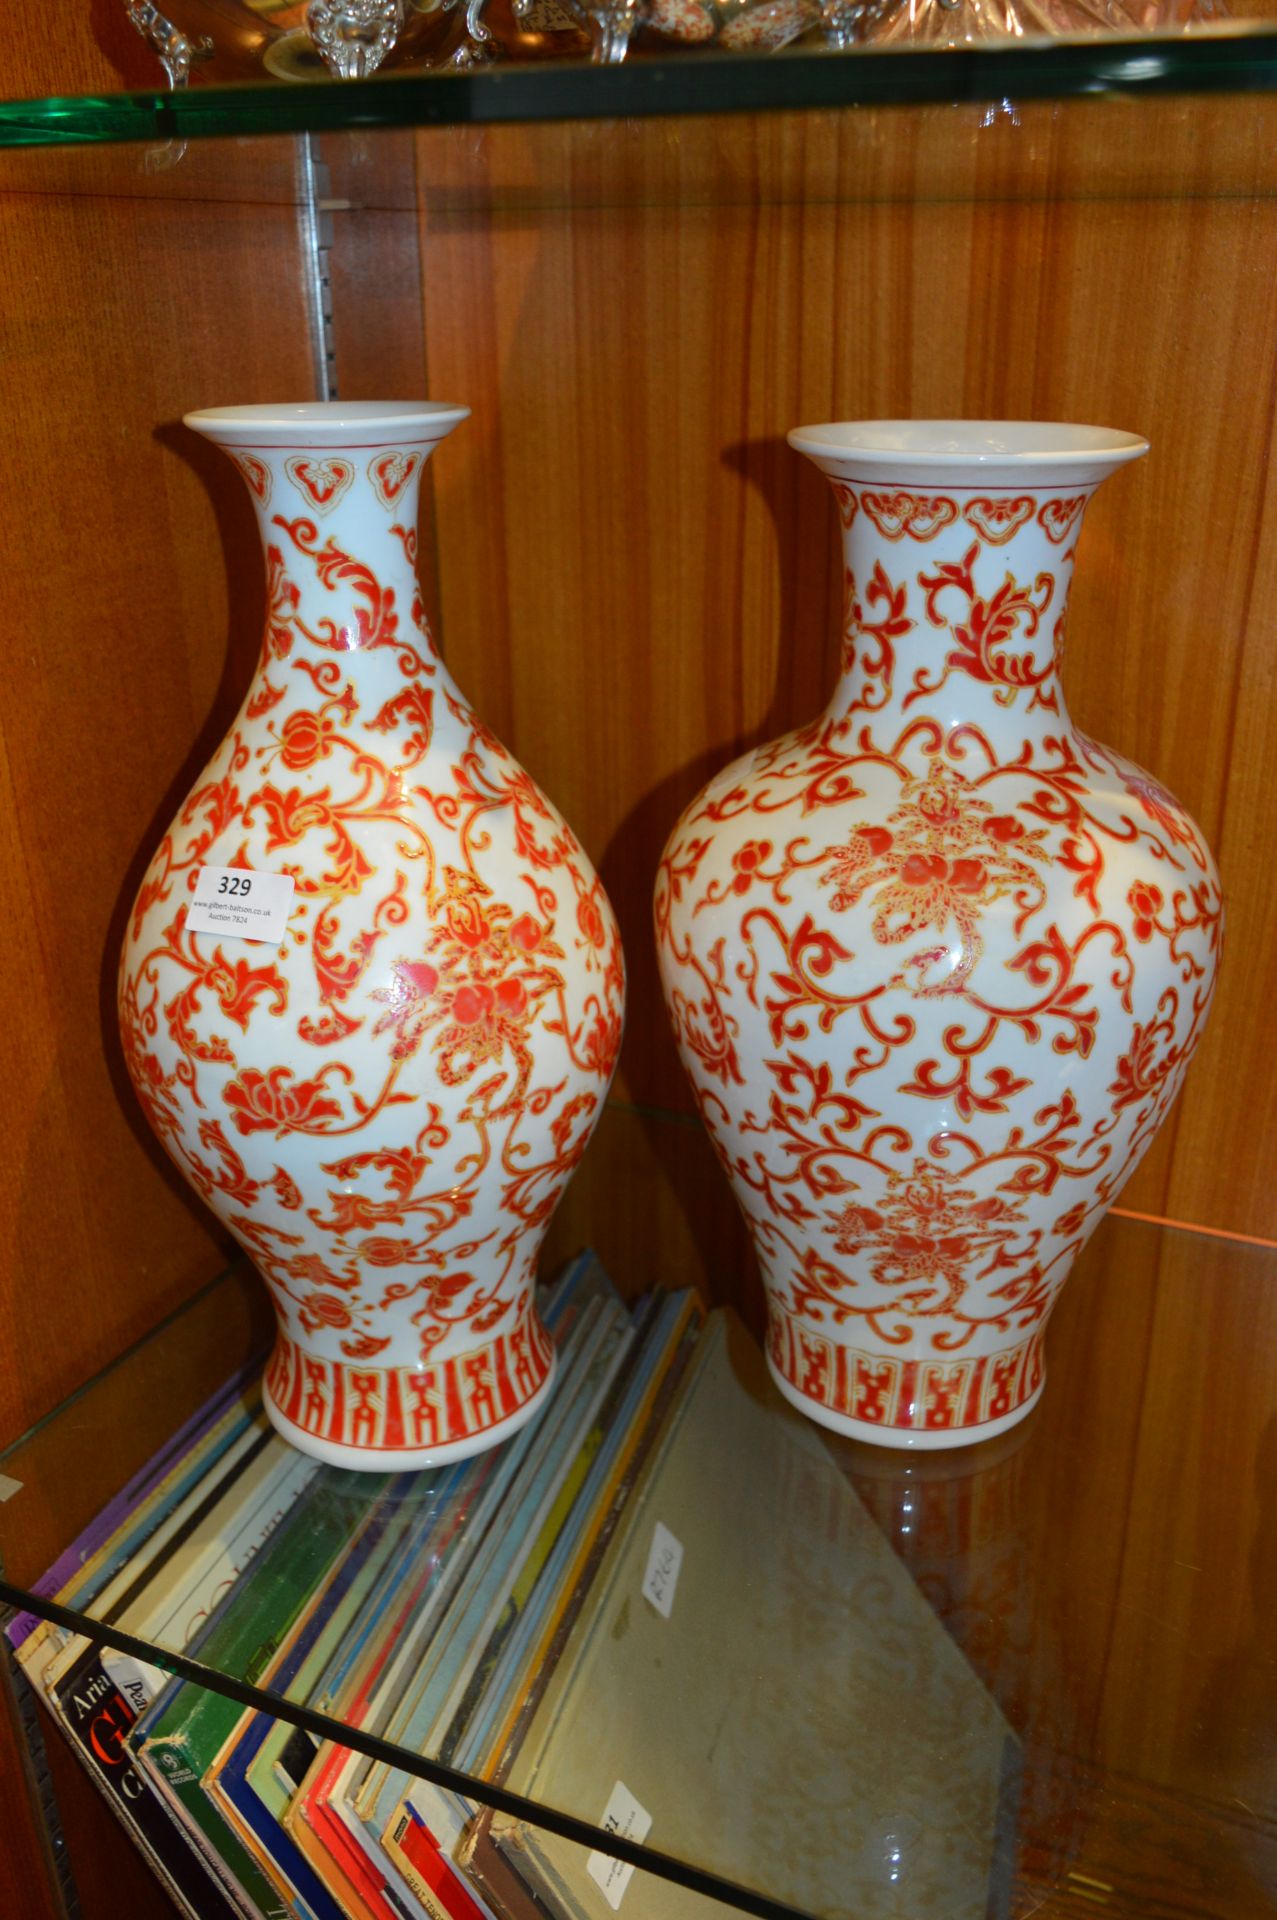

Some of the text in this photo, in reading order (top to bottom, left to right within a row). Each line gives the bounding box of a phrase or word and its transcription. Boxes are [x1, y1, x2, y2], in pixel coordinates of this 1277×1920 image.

[218, 876, 252, 896] 329
[208, 912, 231, 921] Auction
[168, 1768, 192, 1779] WORLD
[170, 1773, 198, 1785] RECORDS
